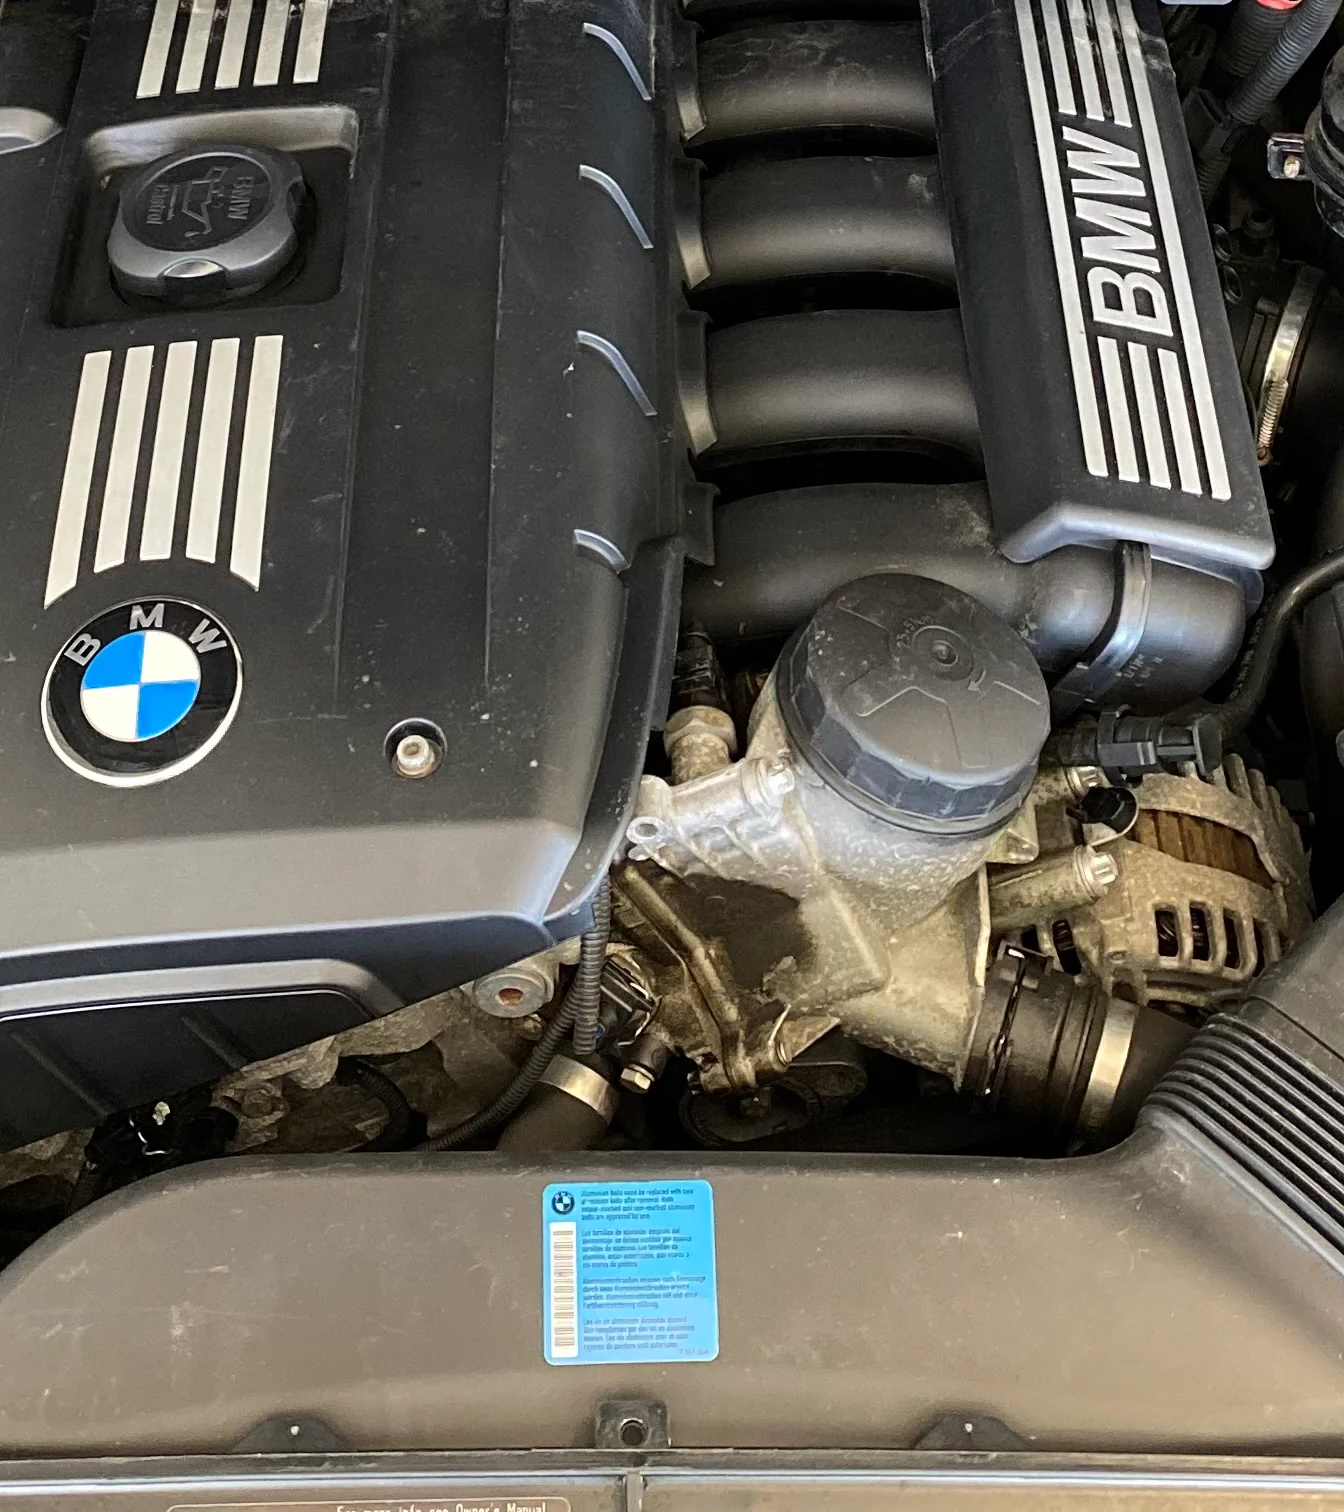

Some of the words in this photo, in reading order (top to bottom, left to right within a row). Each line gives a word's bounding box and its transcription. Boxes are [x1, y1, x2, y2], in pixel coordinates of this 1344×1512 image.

[227, 175, 253, 221] BMW
[1062, 125, 1175, 338] BMW
[63, 602, 228, 669] BMW
